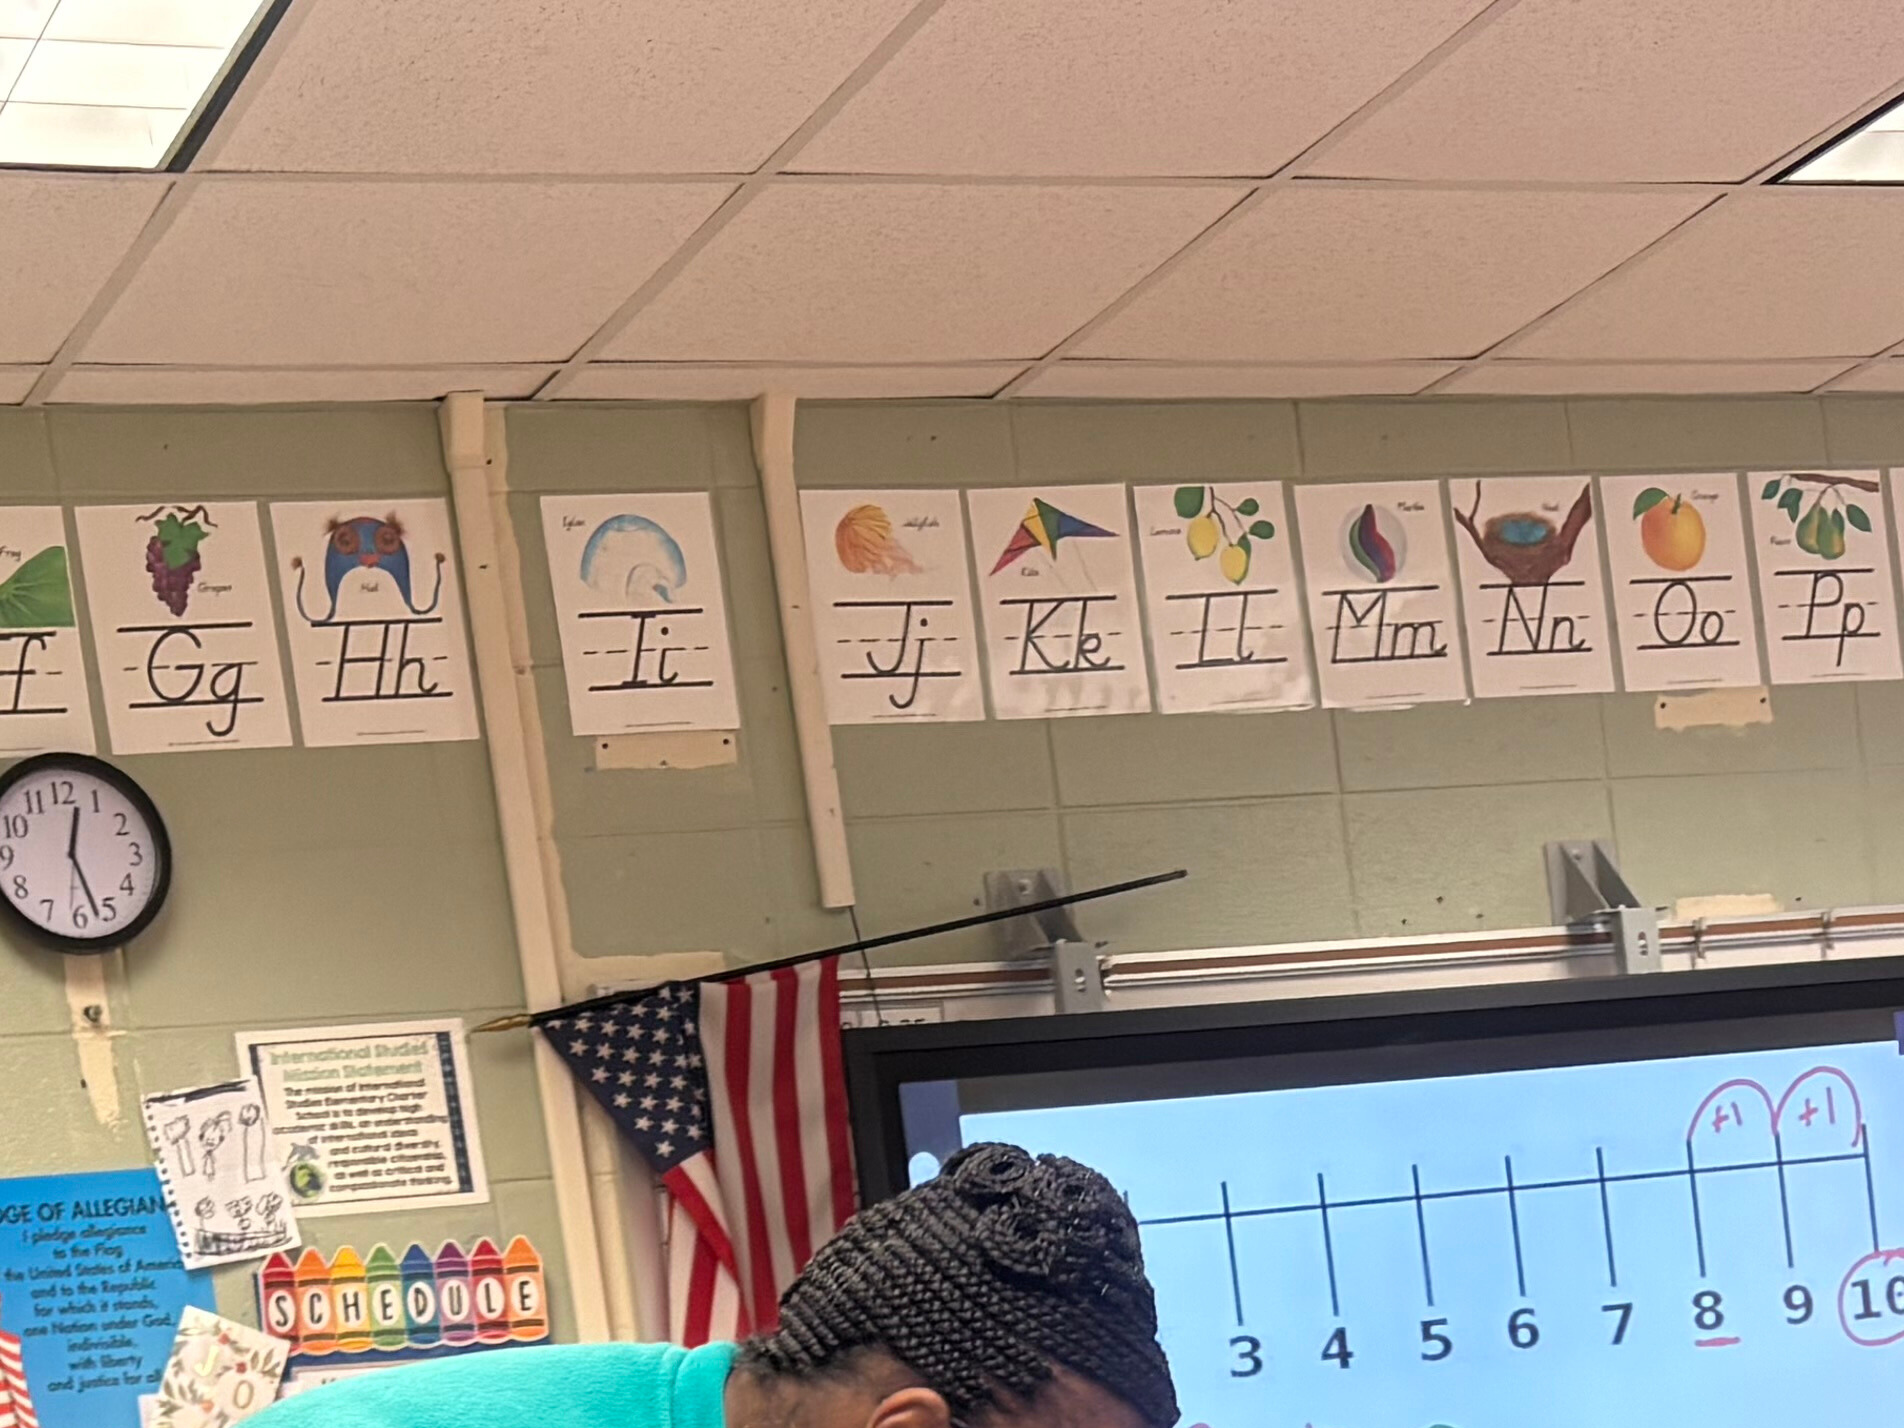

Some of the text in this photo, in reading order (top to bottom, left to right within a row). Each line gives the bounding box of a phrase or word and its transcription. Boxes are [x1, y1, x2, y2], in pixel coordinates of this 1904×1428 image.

[1018, 599, 1110, 671] Kk
[1198, 594, 1254, 665] Ll
[1331, 589, 1447, 662] Mm
[1497, 584, 1587, 653] Nn
[1653, 580, 1724, 646] Oo
[1803, 572, 1866, 667] Pp
[147, 629, 255, 737] Gg
[335, 622, 438, 698] Hh
[621, 614, 679, 686] Ii
[866, 603, 928, 709] Jj
[37, 1203, 66, 1223] OF
[275, 1279, 532, 1329] SCHEDULE
[1229, 1336, 1264, 1379] 3
[1320, 1327, 1354, 1371] 4
[1420, 1319, 1453, 1362] 5
[1508, 1307, 1541, 1350] 6
[1600, 1302, 1635, 1345] 7
[1694, 1291, 1725, 1333] 8
[1782, 1284, 1815, 1325] 9
